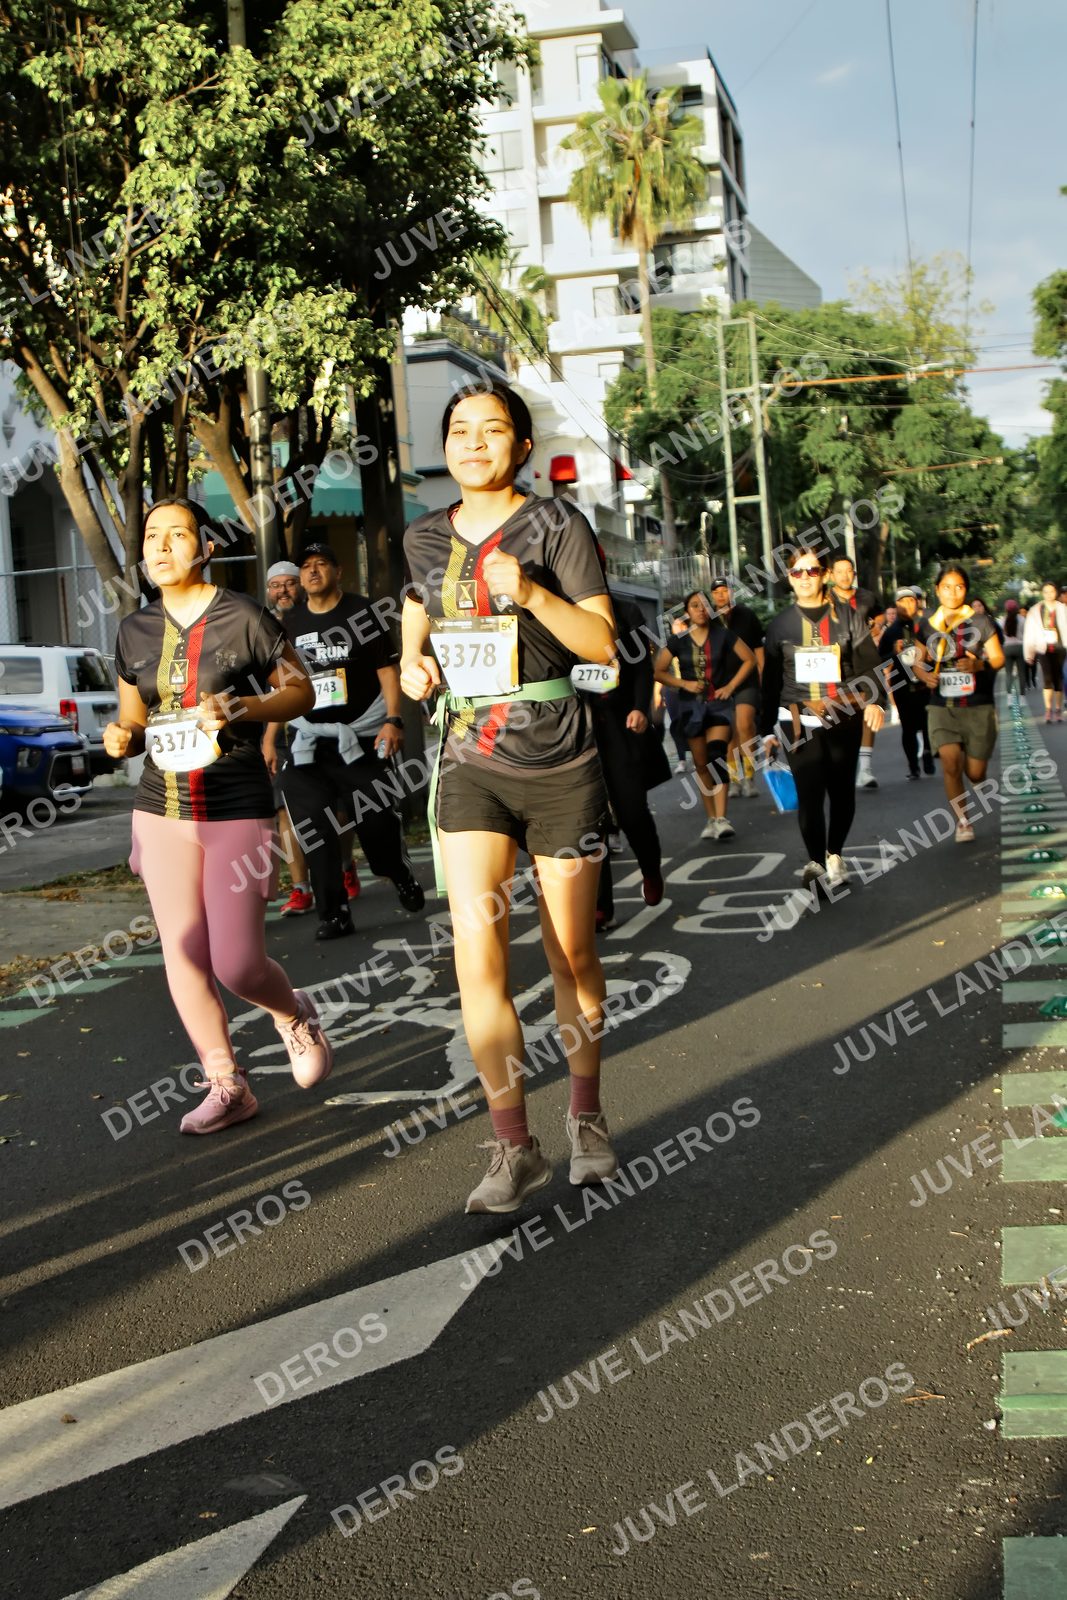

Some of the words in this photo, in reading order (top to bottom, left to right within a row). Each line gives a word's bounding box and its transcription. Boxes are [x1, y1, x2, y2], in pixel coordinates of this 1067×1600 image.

[316, 645, 349, 660] RUN
[440, 643, 497, 668] 3378
[578, 669, 609, 681] 2776
[153, 728, 198, 753] 3377
